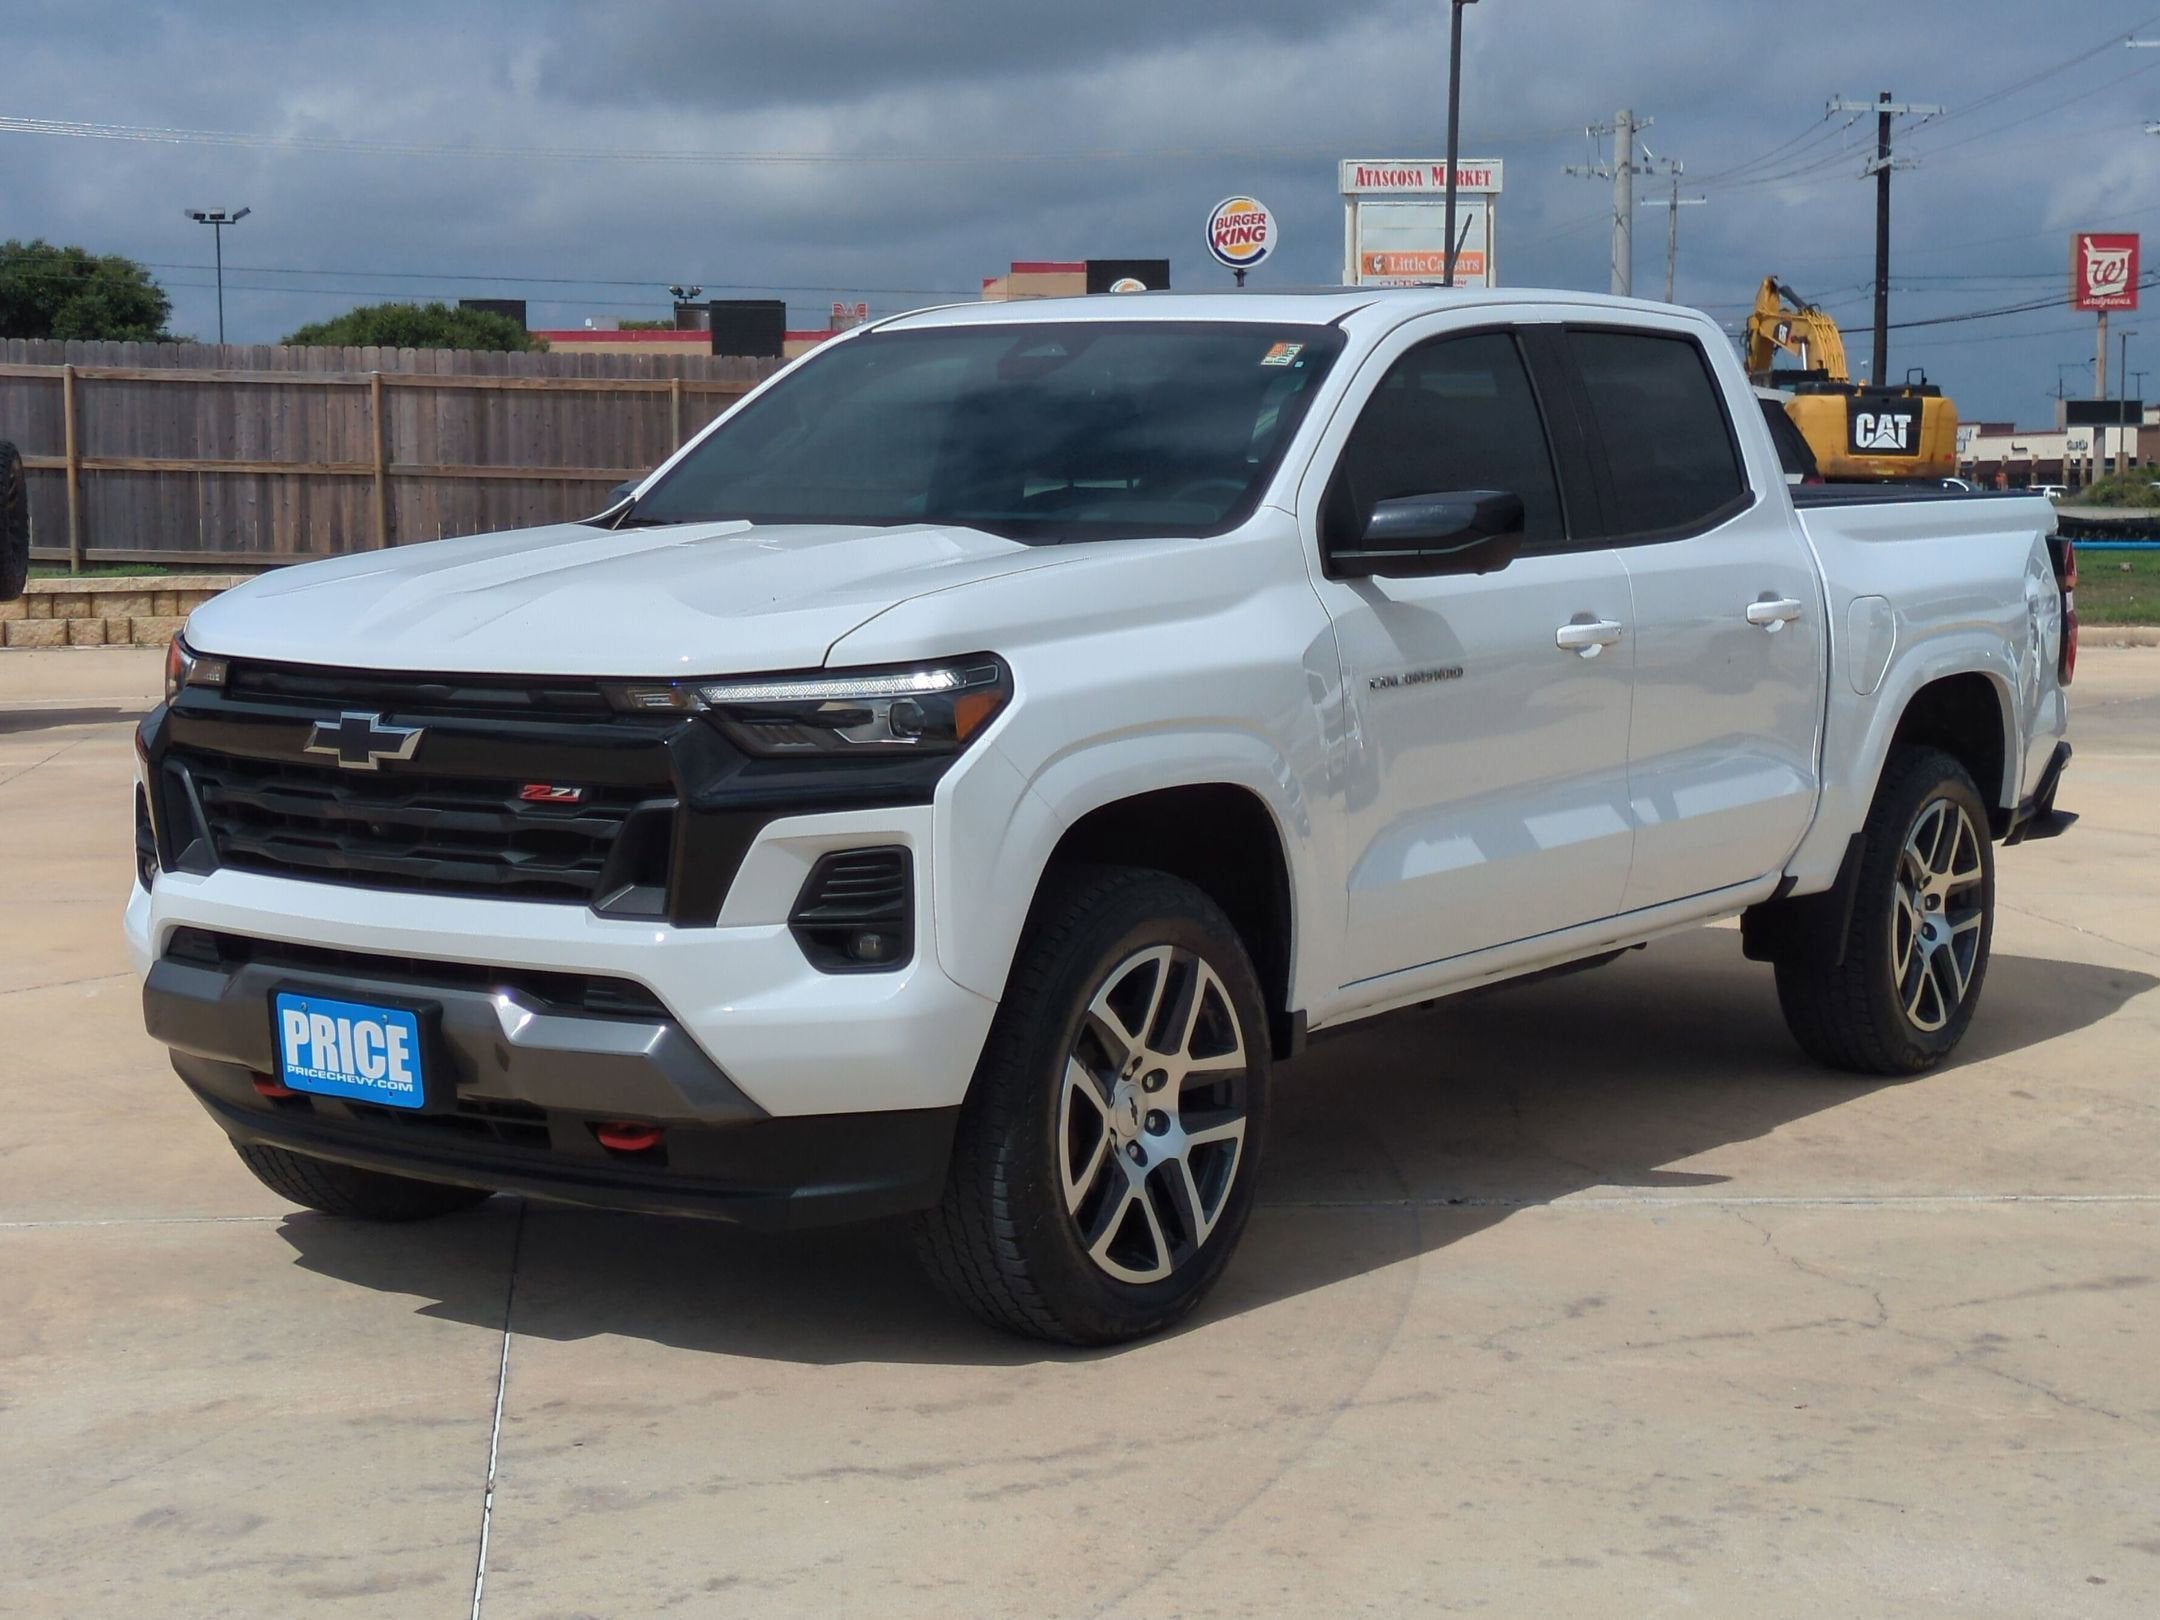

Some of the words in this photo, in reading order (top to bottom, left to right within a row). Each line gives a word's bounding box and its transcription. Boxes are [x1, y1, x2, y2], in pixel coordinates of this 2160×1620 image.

[1355, 167, 1424, 187] ATASCOSA
[1432, 166, 1491, 187] MRKET
[1215, 213, 1266, 231] BURGER
[1215, 226, 1267, 249] KING
[1390, 255, 1426, 272] Little
[1856, 413, 1912, 449] CAT
[520, 784, 583, 802] Z71
[282, 1009, 414, 1083] PRICE
[287, 1065, 414, 1092] PRICECHEVY.COM
